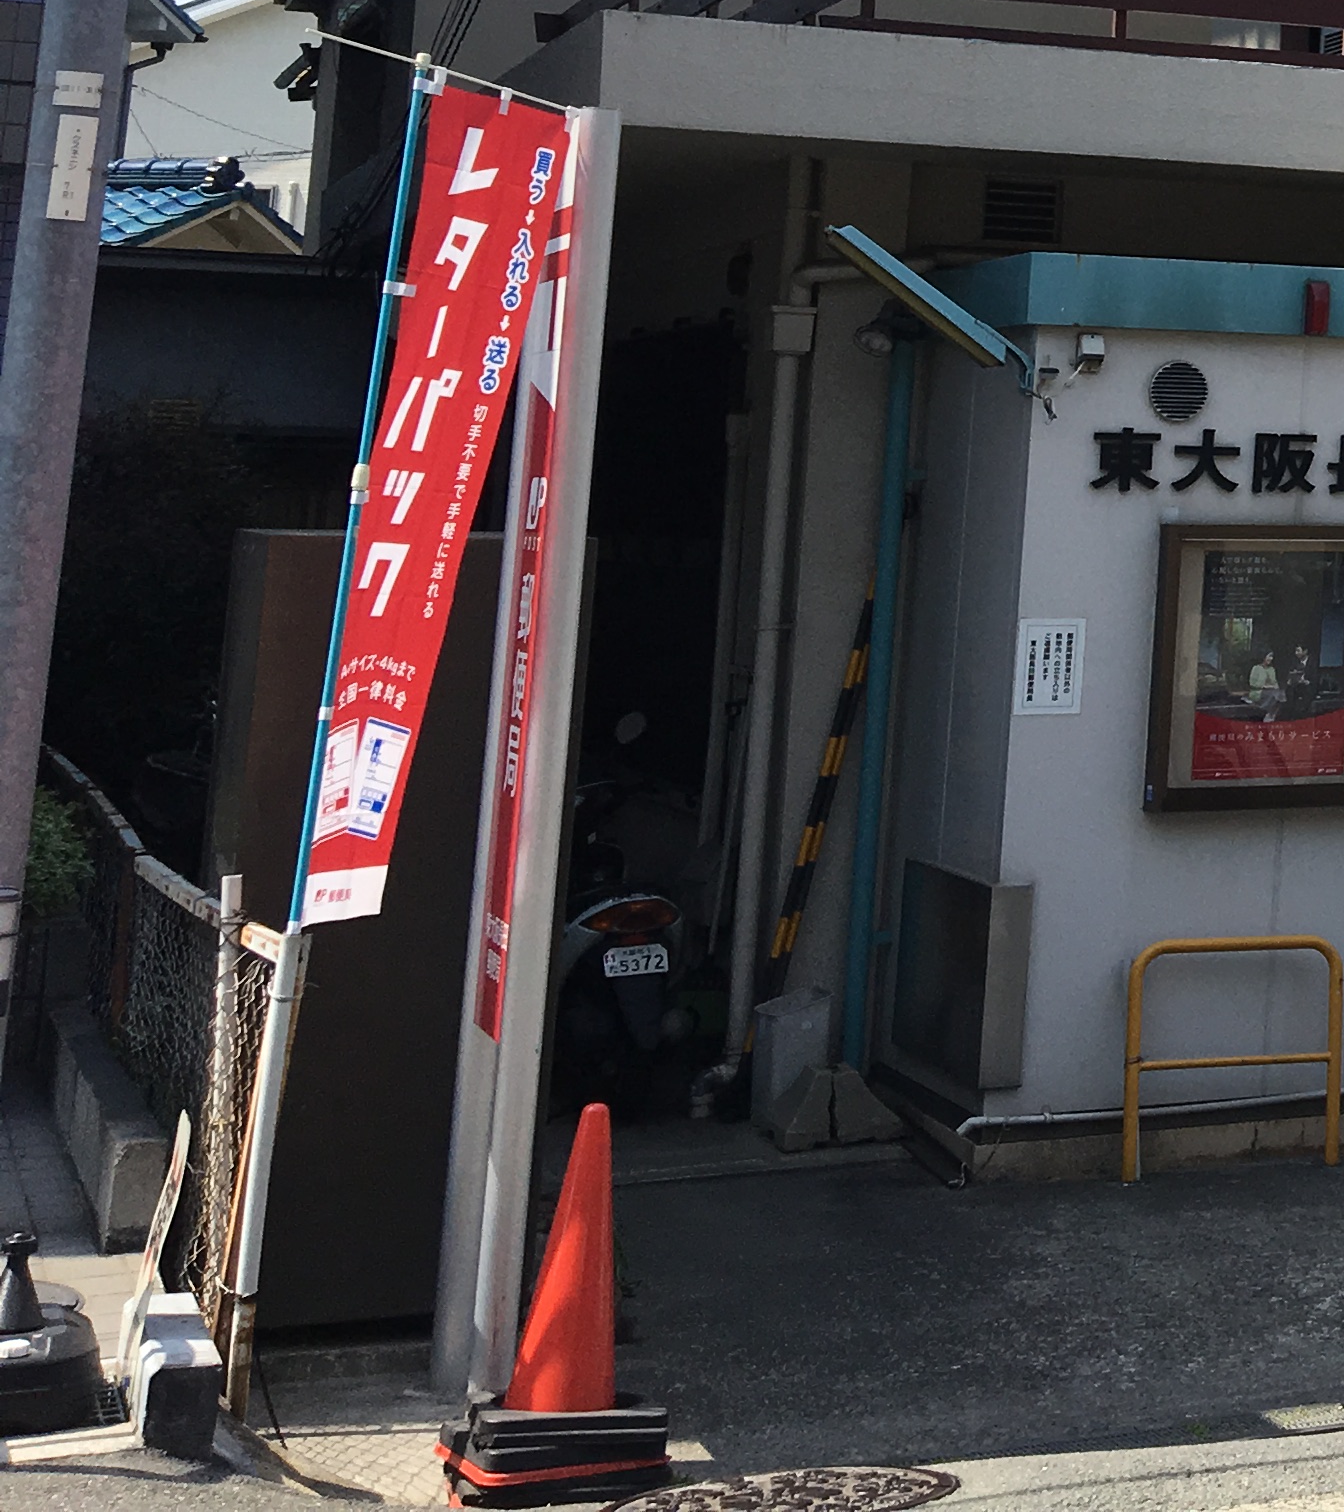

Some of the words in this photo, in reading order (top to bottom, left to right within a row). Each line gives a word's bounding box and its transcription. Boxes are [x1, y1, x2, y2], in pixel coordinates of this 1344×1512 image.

[529, 148, 555, 204] 買う
[501, 228, 534, 310] 入れる
[358, 127, 499, 617] レターパック
[480, 335, 510, 393] 送る
[422, 404, 488, 619] 切手不要で手軽に送れる
[337, 680, 407, 712] 全国一律料金
[620, 953, 665, 973] 5372
